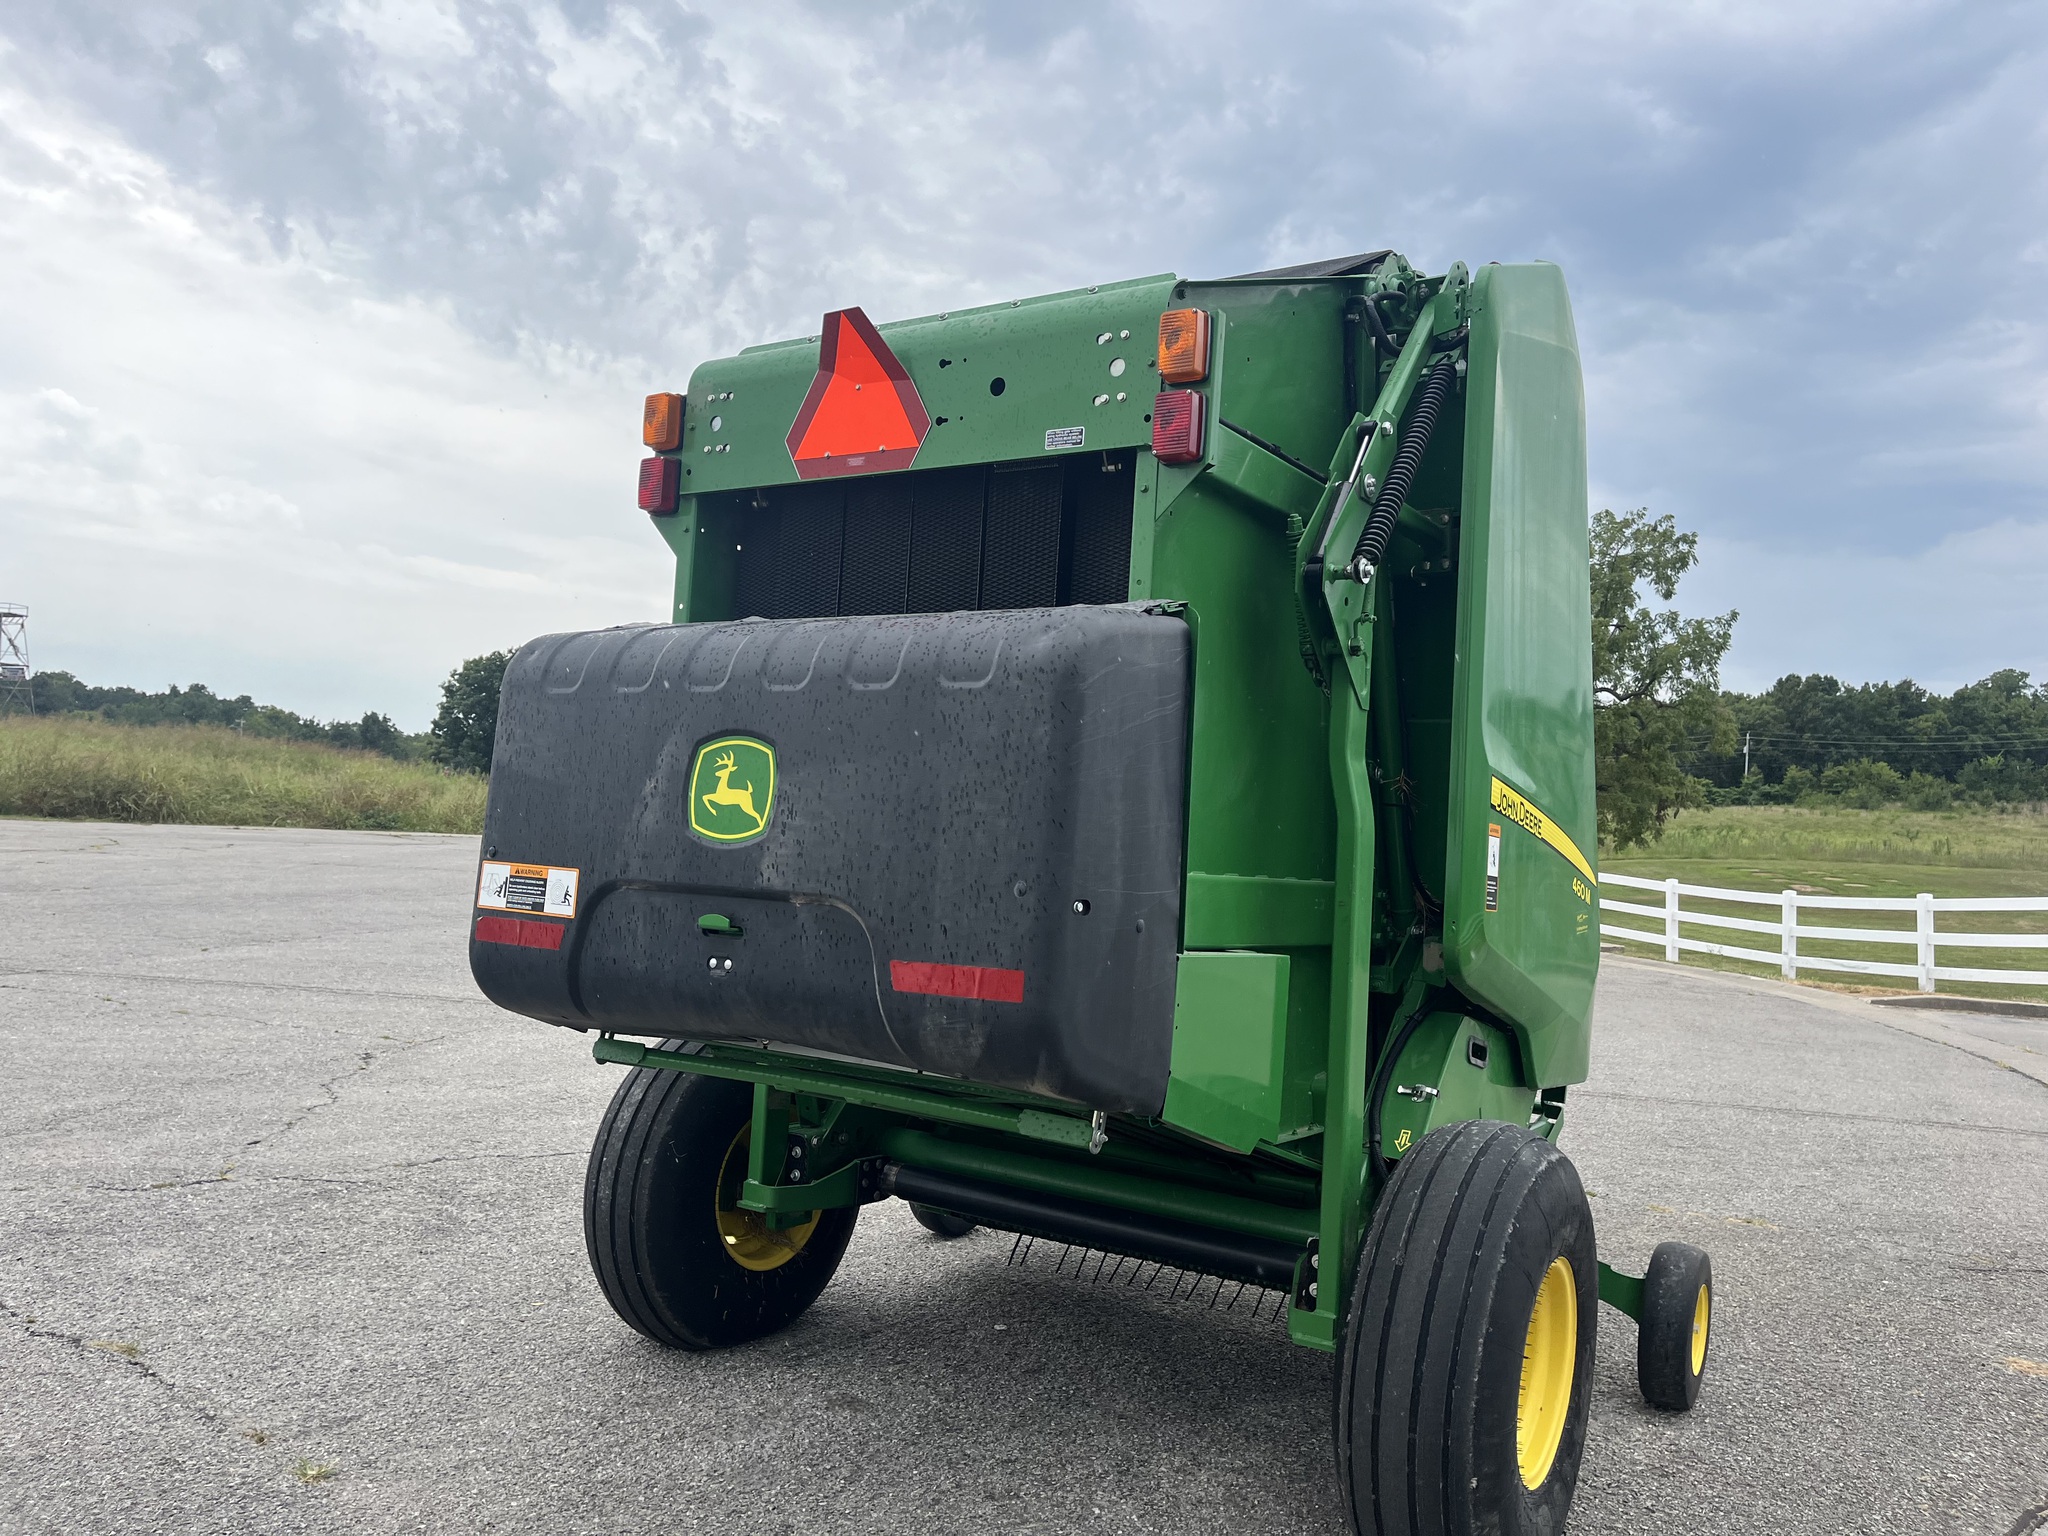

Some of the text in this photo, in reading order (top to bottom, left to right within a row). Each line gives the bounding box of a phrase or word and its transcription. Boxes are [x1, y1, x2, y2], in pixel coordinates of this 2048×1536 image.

[1497, 788, 1543, 836] JOHN DEERE
[520, 869, 543, 877] WARNING
[1572, 876, 1586, 901] 460
